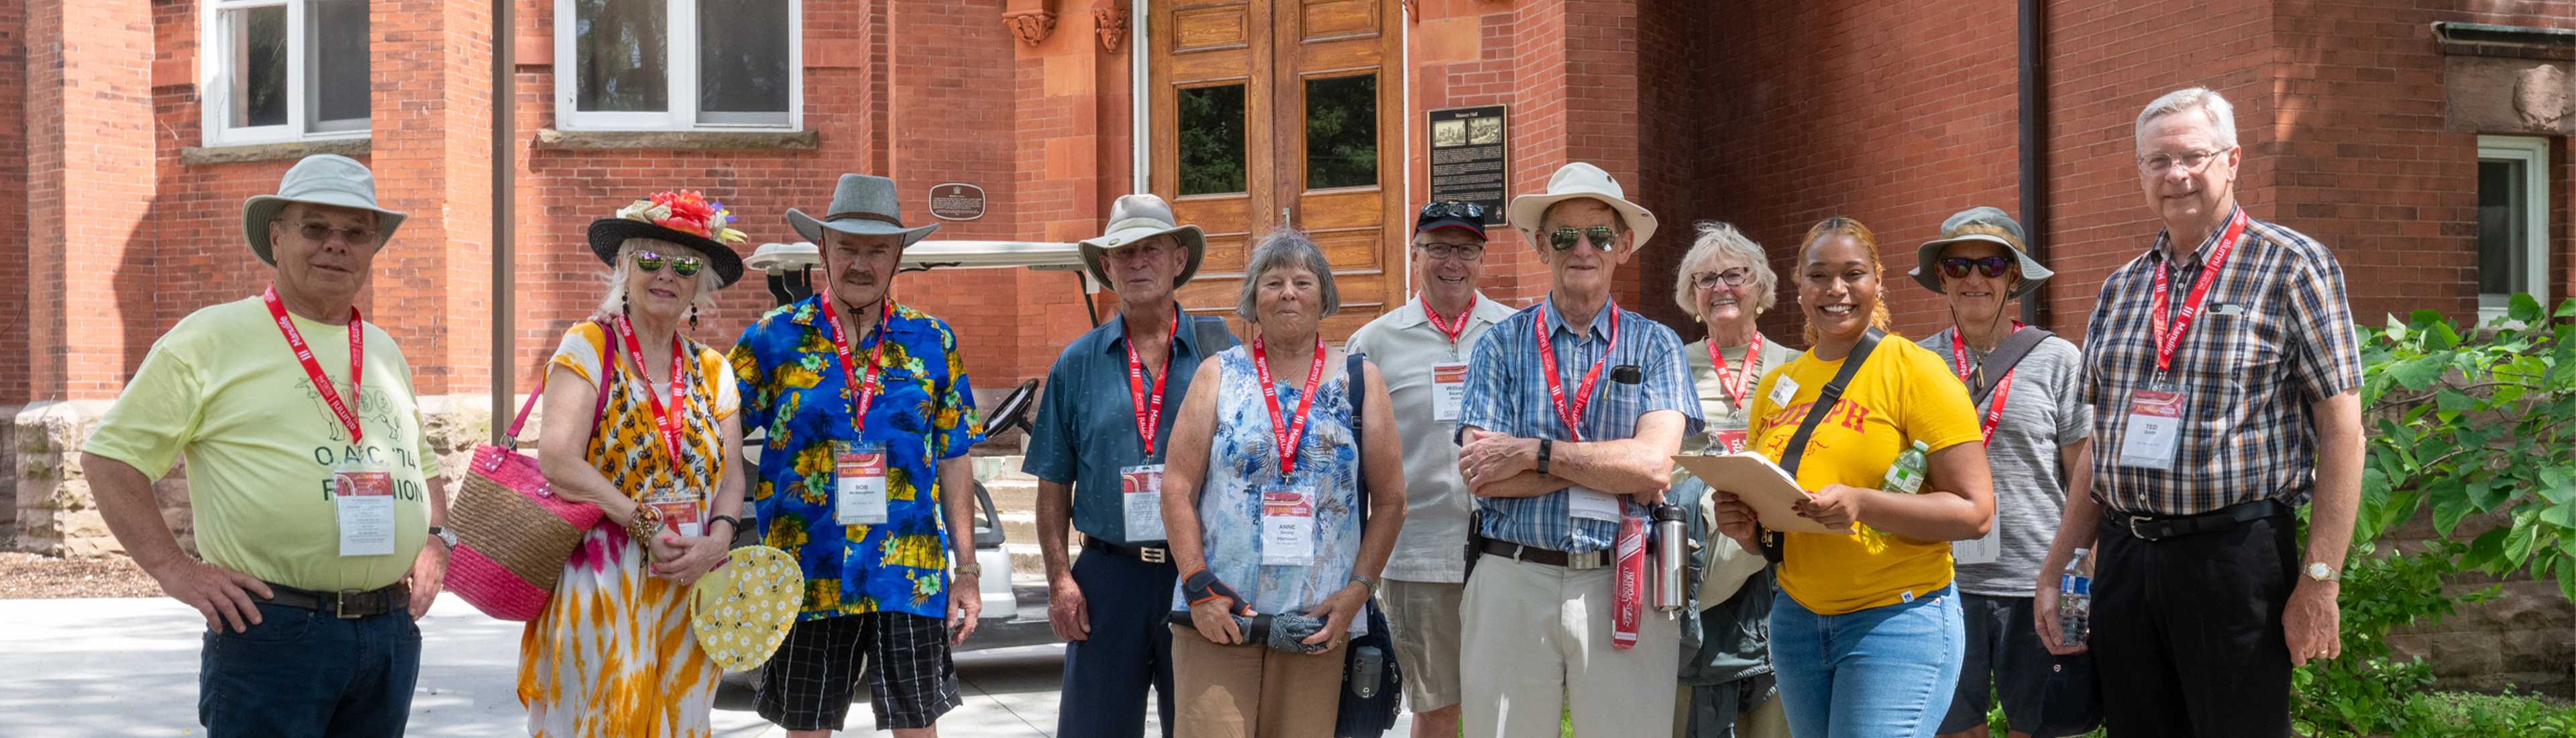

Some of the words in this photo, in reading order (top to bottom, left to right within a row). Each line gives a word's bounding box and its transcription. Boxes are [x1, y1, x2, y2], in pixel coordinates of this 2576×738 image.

[2212, 238, 2232, 268] alumni
[280, 316, 301, 347] Manulife
[351, 319, 361, 344] alumni
[831, 316, 845, 342] Manulife
[1538, 321, 1547, 348] alumni
[2163, 321, 2186, 356] Manulife
[674, 356, 683, 384] Manulife
[1258, 356, 1270, 383] Manulife
[1309, 358, 1322, 382] alumni
[1955, 348, 1968, 376] Manulife
[333, 400, 356, 431] alumni
[859, 386, 871, 416] Manulife
[1148, 409, 1159, 440] Manulife
[1285, 428, 1299, 458] Manulife
[1621, 566, 1629, 602] UNIVERSITY
